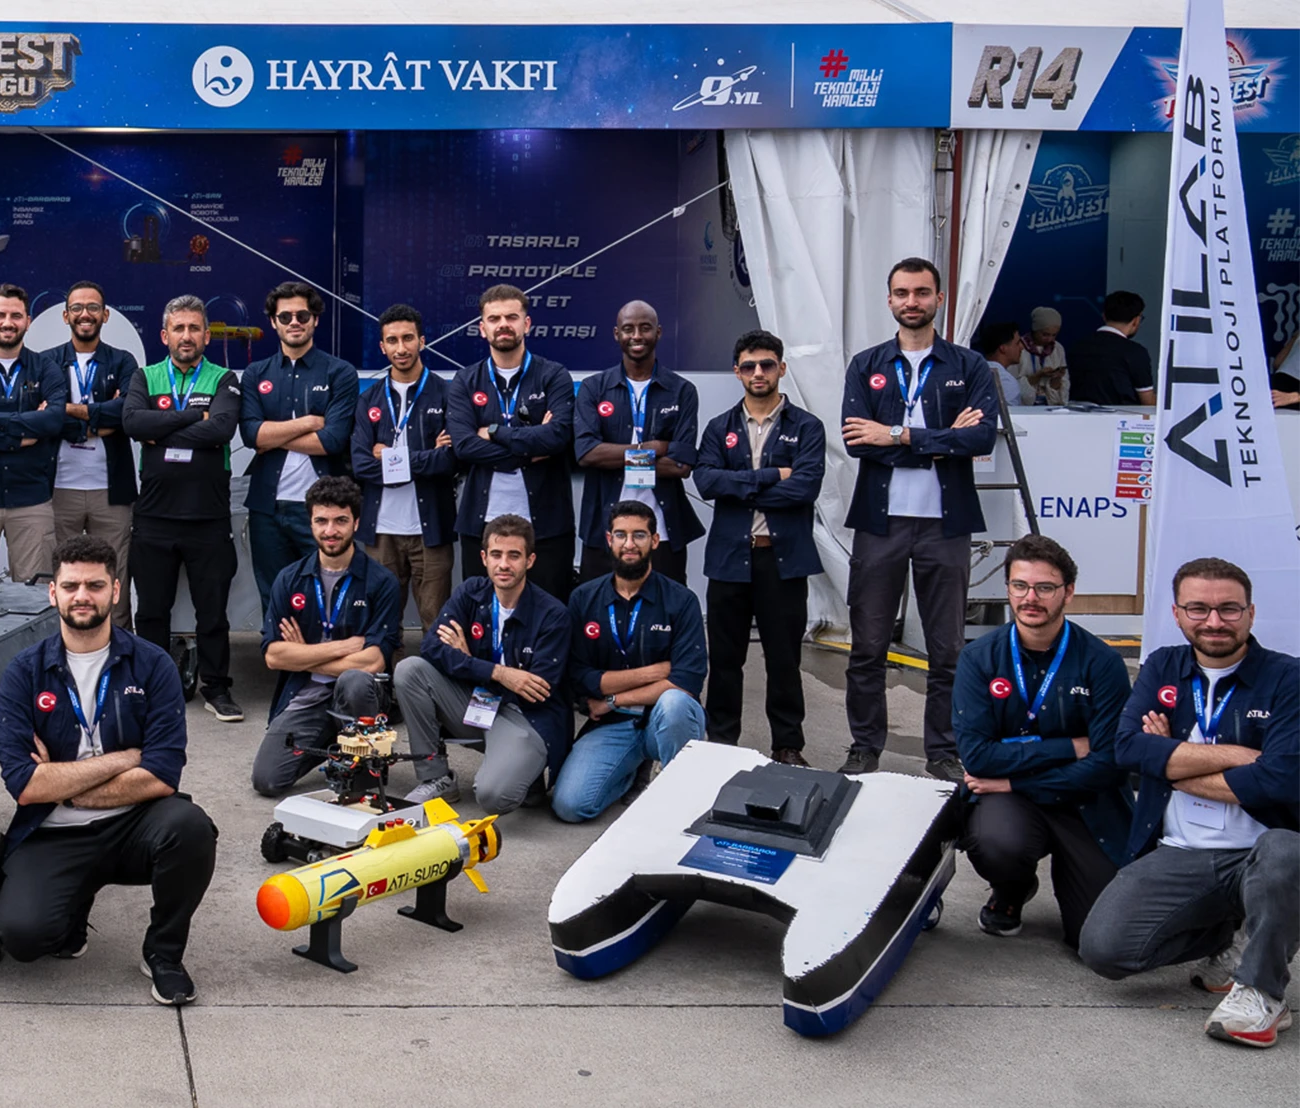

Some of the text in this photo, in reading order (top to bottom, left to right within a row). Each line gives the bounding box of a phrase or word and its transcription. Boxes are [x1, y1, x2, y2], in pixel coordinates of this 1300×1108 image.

[267, 53, 557, 91] HAYRÂT VAKFI
[967, 45, 1083, 110] R14
[1209, 85, 1233, 286] PLATFORMU
[487, 235, 580, 248] TASARLA
[468, 264, 597, 278] PROTOTİPLE
[546, 296, 572, 307] ET
[553, 325, 597, 340] TAŞI
